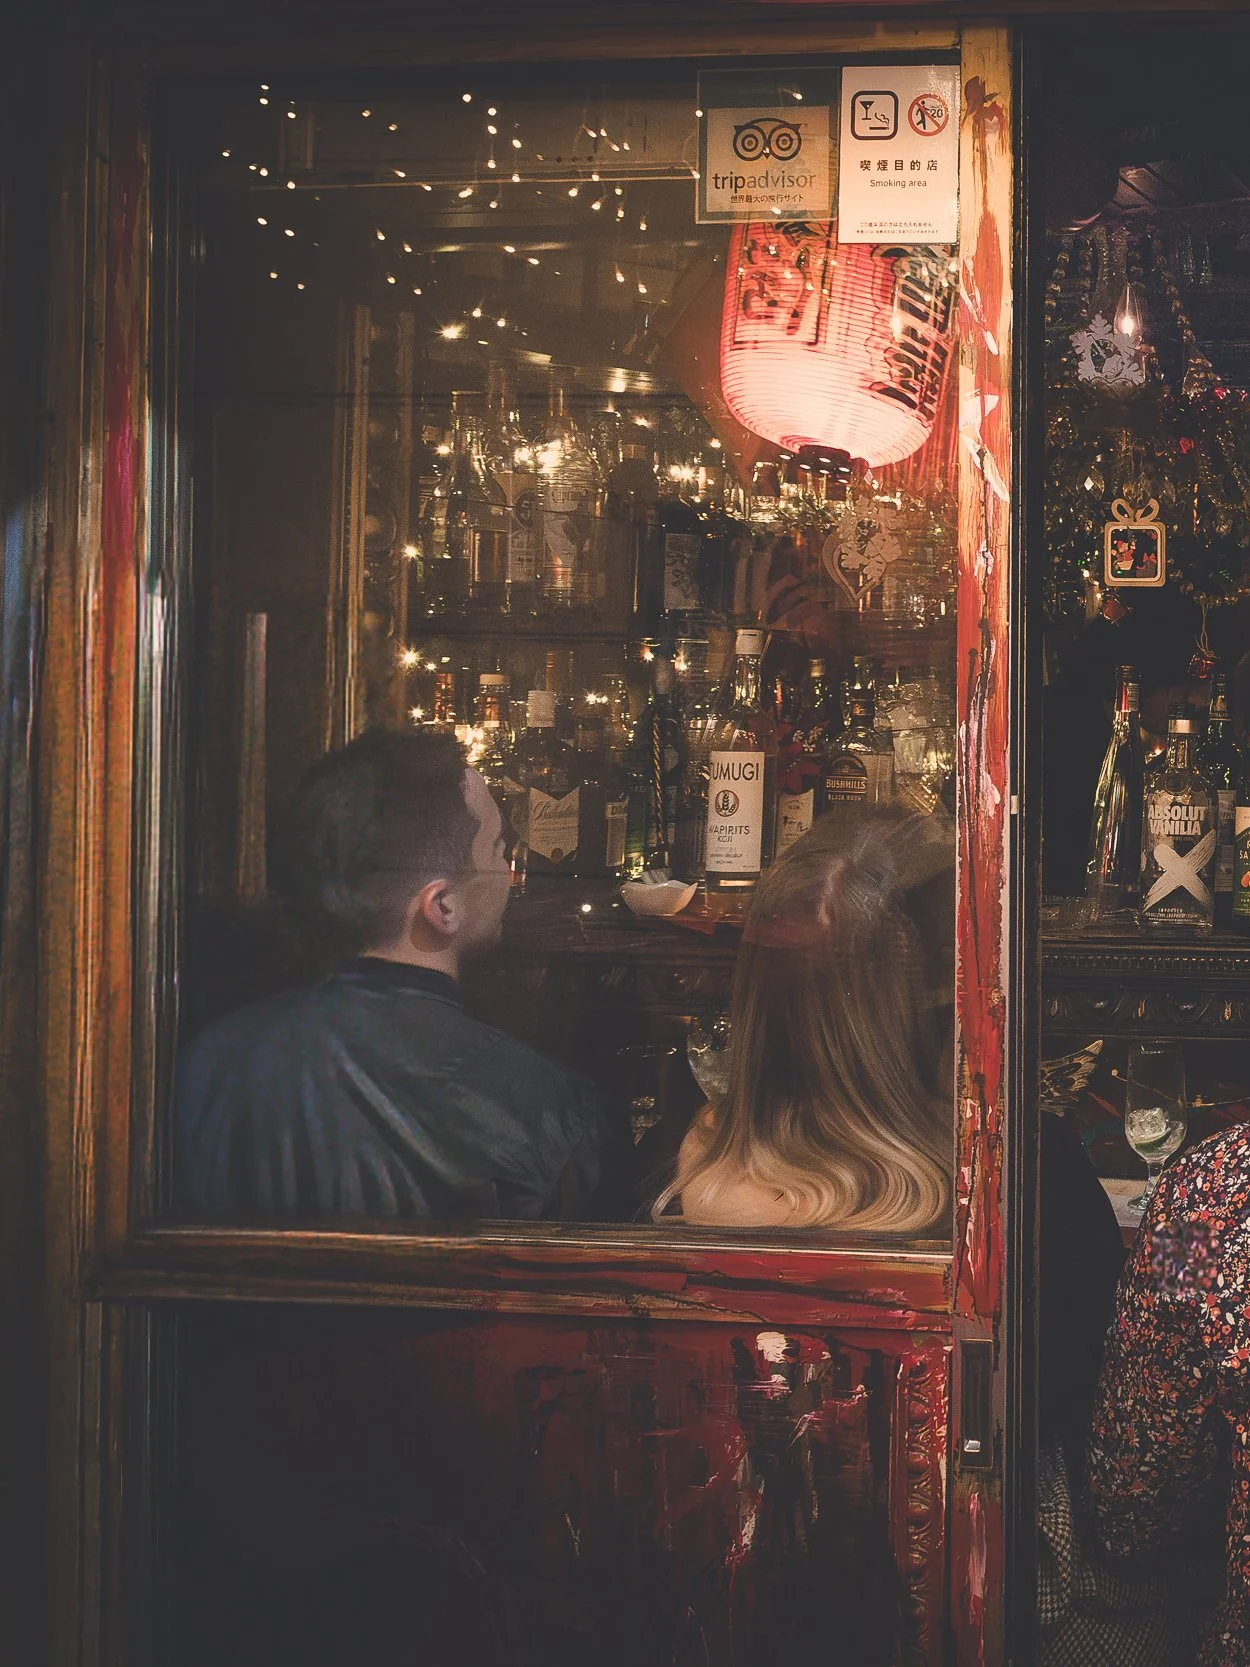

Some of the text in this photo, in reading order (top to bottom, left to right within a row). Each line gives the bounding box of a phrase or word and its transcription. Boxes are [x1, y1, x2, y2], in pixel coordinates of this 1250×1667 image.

[860, 159, 938, 171] 喫煙目的店
[712, 170, 817, 193] tripadvisor
[870, 179, 906, 188] Smoking
[710, 762, 760, 781] UMUGI
[1148, 805, 1208, 821] ABSOLUT
[1150, 820, 1202, 836] VANILIA
